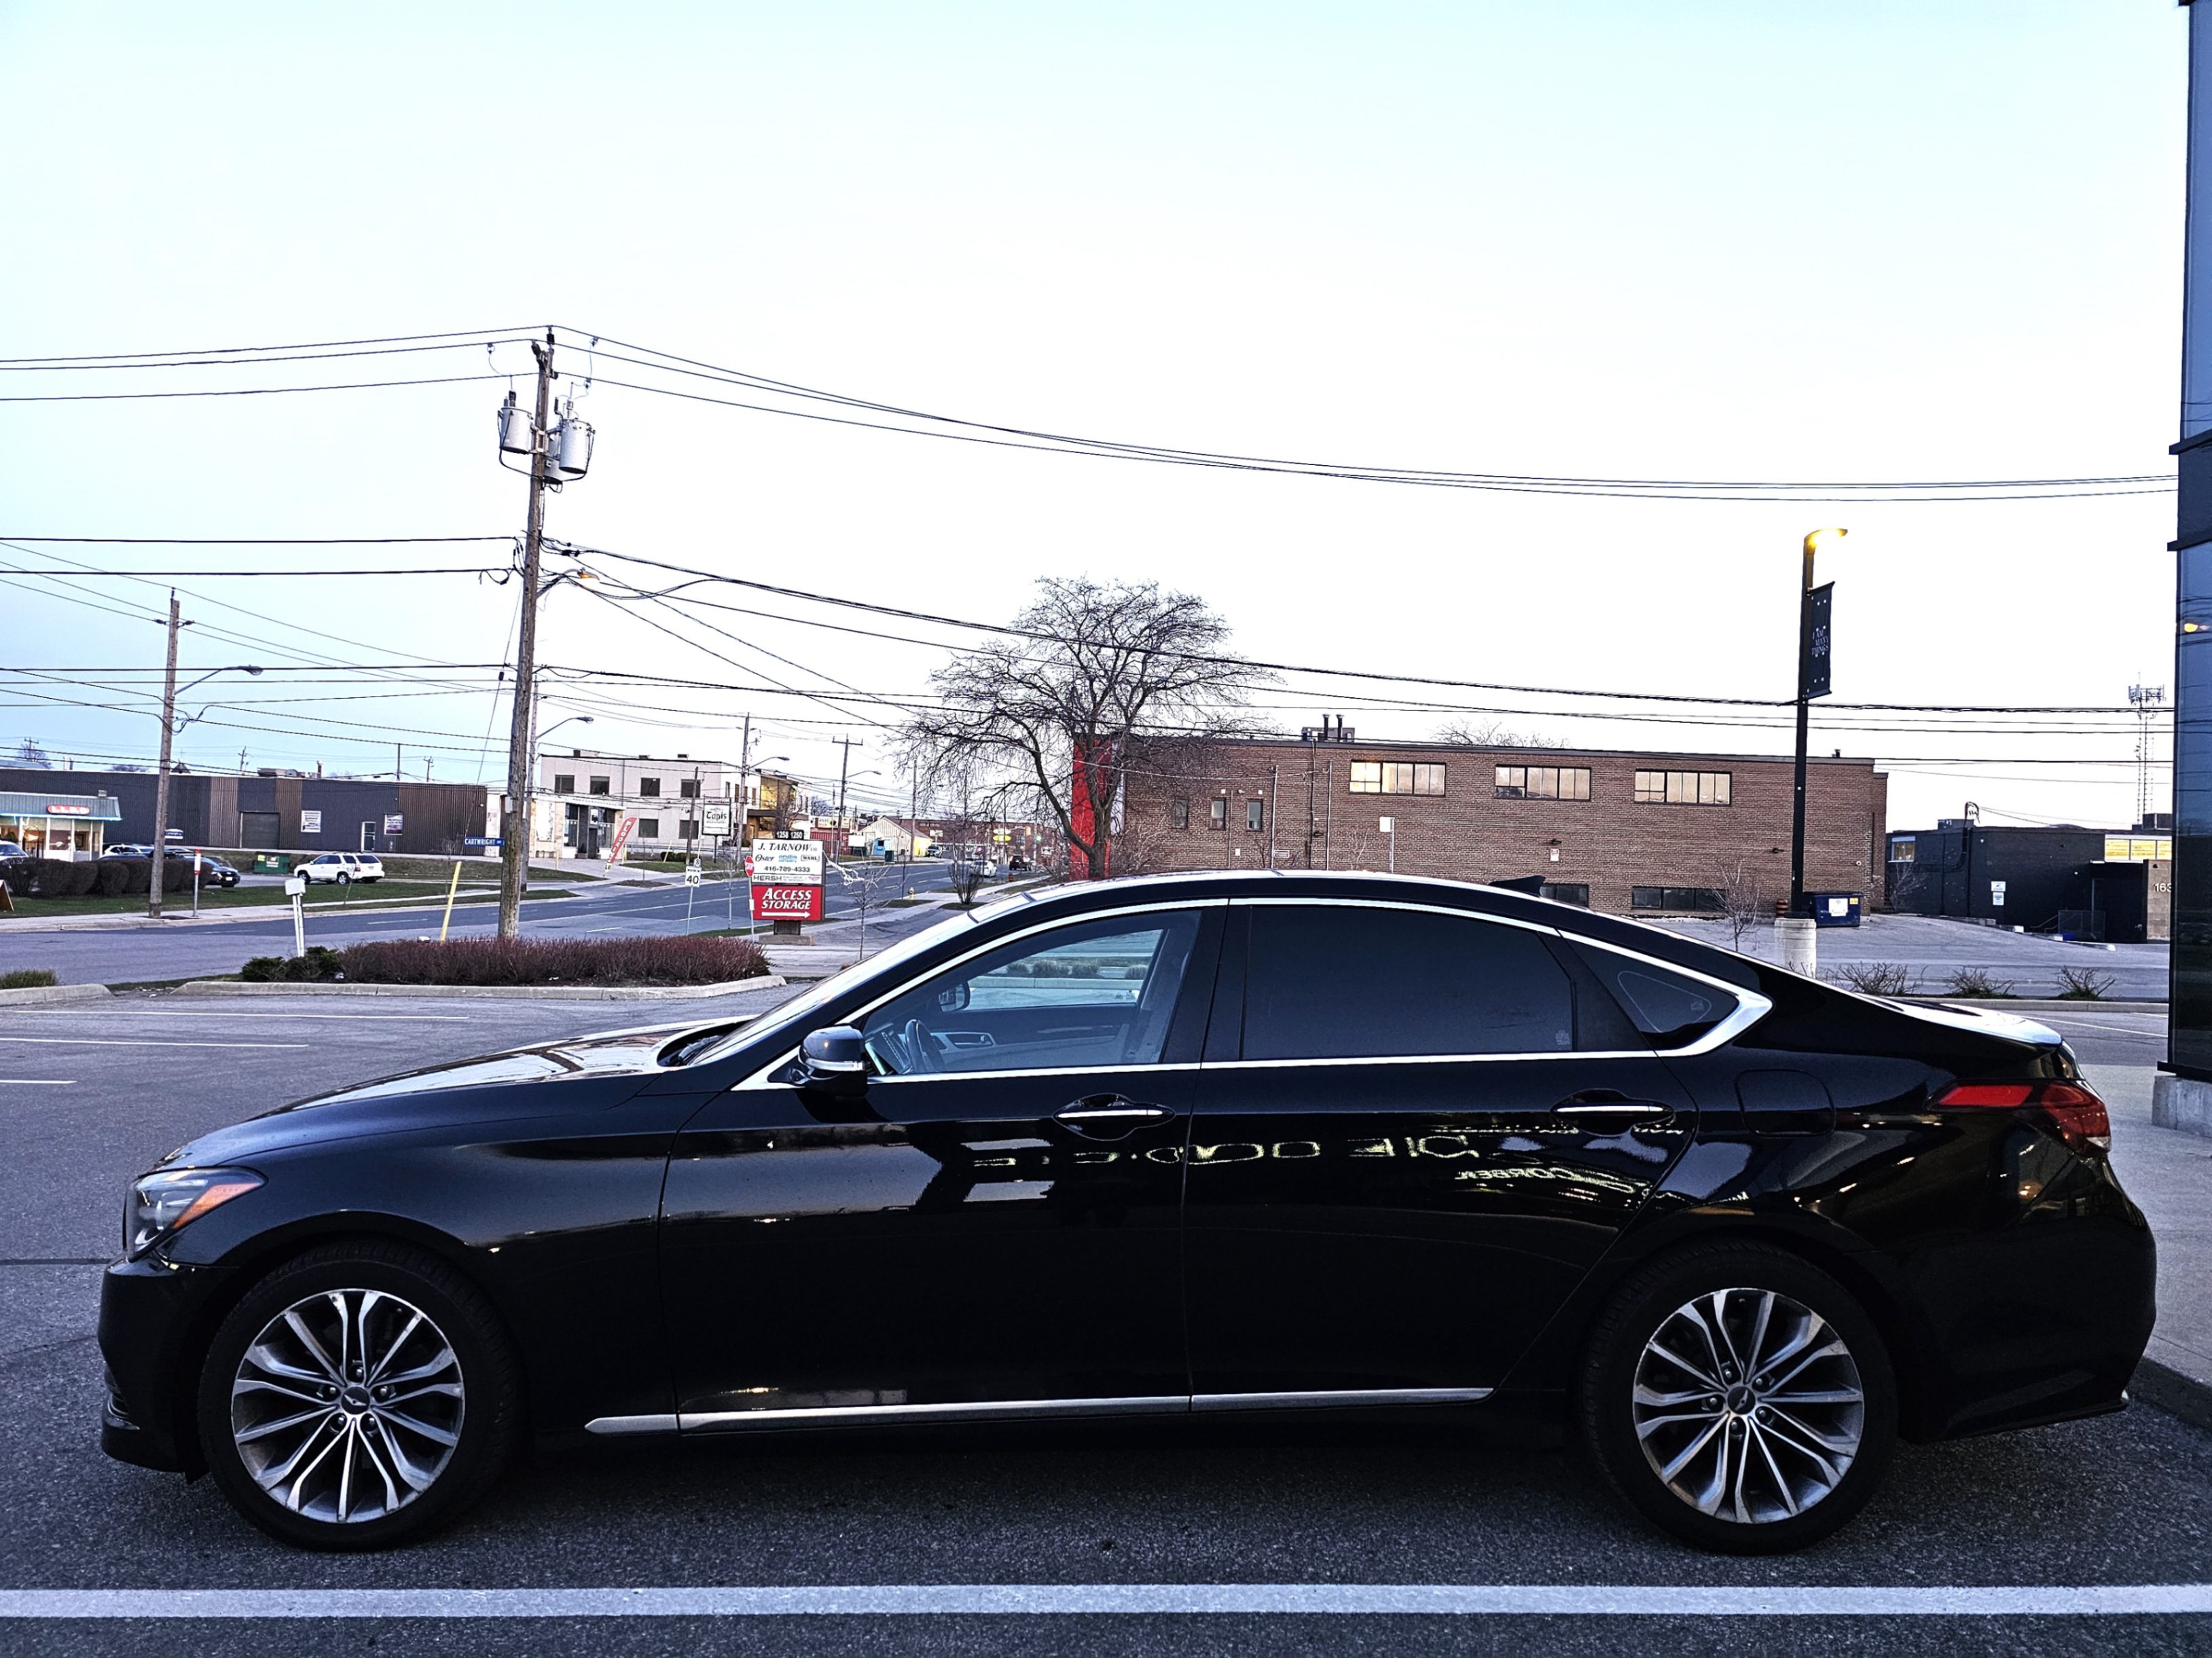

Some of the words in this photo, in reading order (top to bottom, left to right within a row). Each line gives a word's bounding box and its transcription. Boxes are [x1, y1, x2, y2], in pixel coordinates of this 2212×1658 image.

[769, 843, 811, 851] TARNOW
[687, 875, 699, 884] 40
[762, 887, 812, 900] ACCESS
[761, 900, 811, 910] STORAGE
